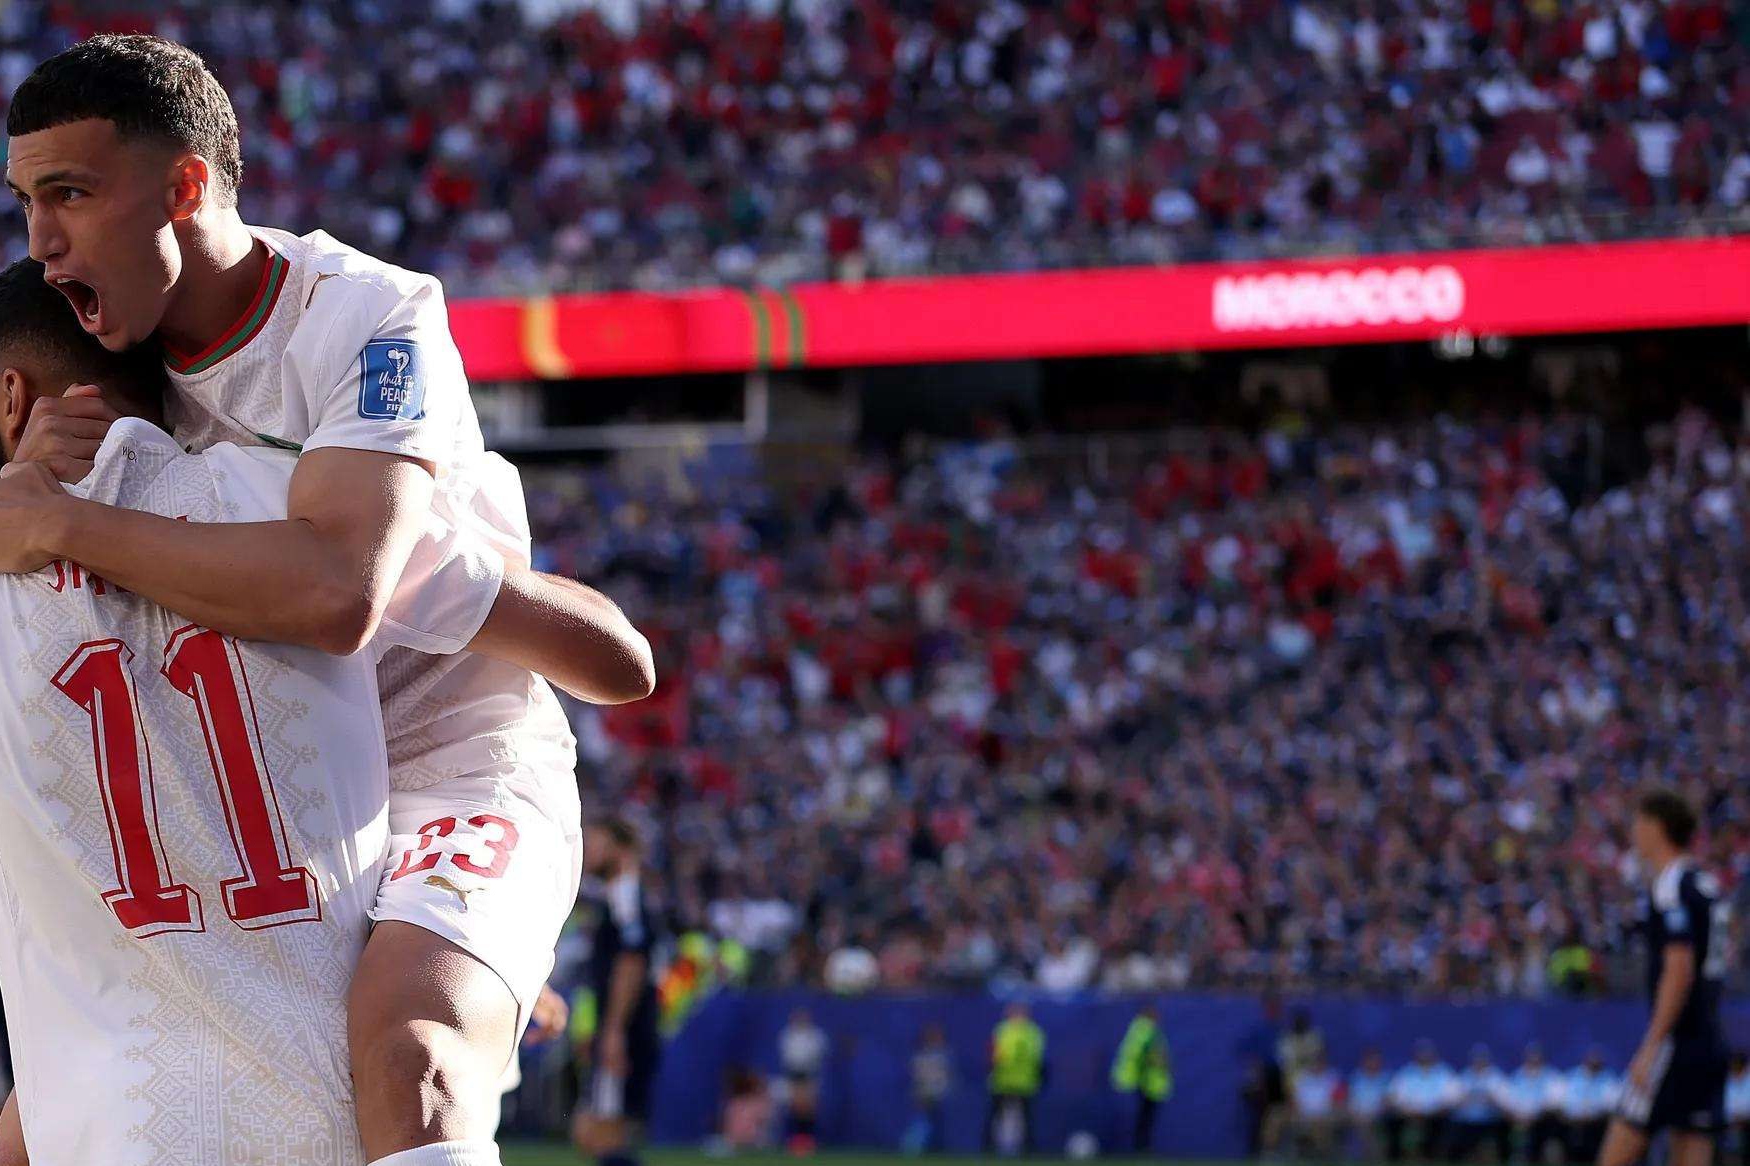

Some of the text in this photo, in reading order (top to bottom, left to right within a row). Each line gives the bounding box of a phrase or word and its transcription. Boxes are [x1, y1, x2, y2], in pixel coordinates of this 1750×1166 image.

[1212, 265, 1464, 332] MOROCCO
[380, 386, 412, 404] PEACE
[386, 403, 404, 412] FIFA
[50, 623, 323, 939] 11
[390, 814, 520, 881] 23
